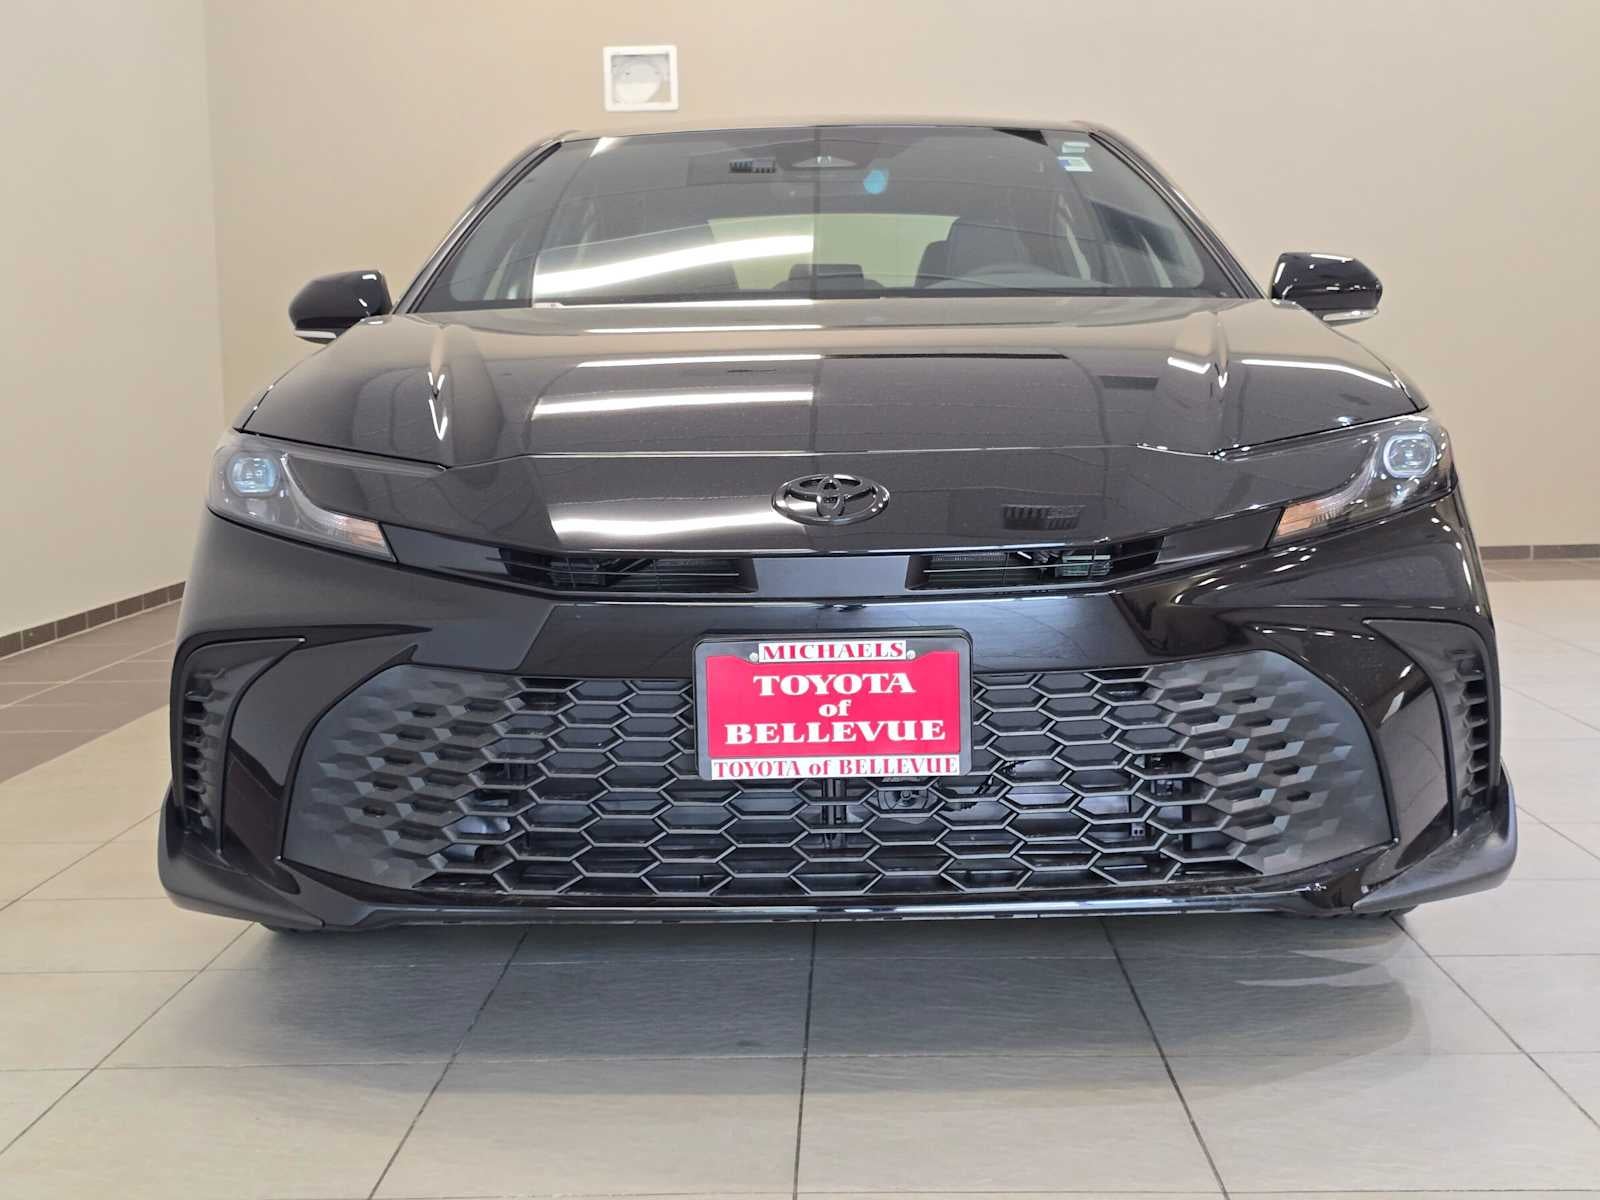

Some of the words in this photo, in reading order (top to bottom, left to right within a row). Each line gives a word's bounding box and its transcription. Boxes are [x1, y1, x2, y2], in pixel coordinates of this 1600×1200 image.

[763, 642, 904, 660] MICHAELS
[753, 672, 916, 696] TOYOTA
[818, 699, 852, 717] of
[724, 720, 946, 745] BELLEVUE
[714, 760, 801, 778] TOYOTA
[809, 759, 831, 776] of
[839, 757, 958, 775] BELLEVUE
